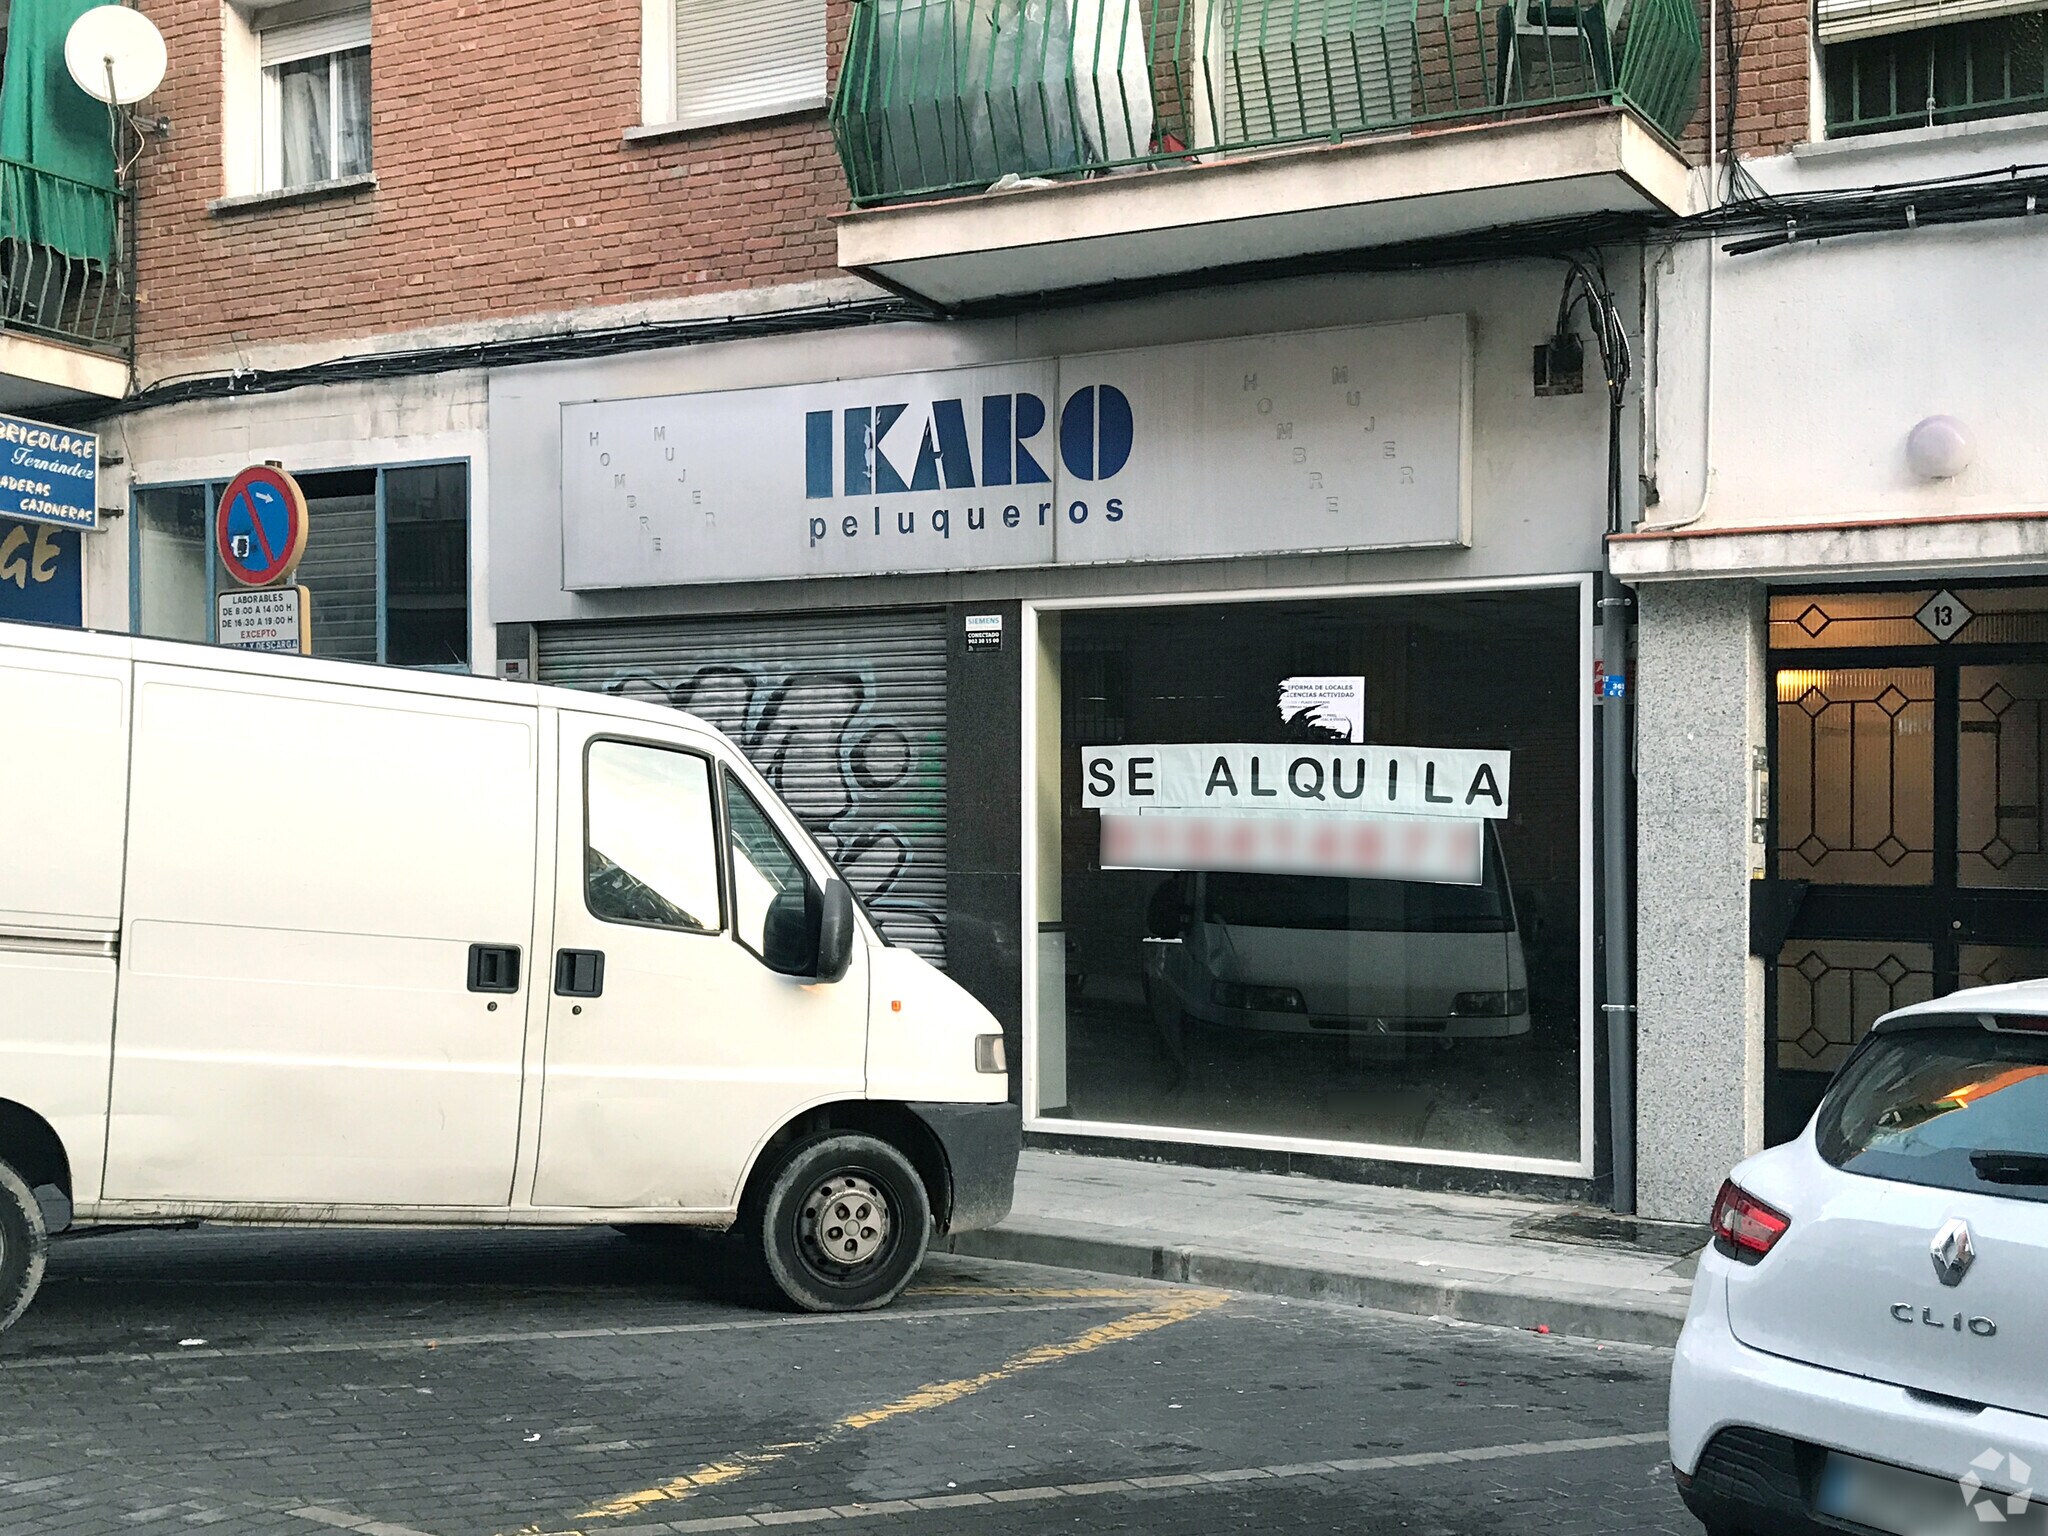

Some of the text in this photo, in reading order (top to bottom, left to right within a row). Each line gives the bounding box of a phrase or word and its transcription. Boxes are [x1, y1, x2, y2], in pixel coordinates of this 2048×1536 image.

[806, 384, 1134, 500] IKARO
[10, 447, 94, 479] Fernández
[0, 475, 51, 496] ADERAS
[20, 498, 93, 522] CAJONERAS
[809, 498, 1124, 547] peluqueros
[232, 593, 284, 604] LABORABLES
[222, 607, 233, 616] DE
[255, 605, 261, 614] A
[1934, 605, 1953, 626] 13
[221, 619, 232, 628] DE
[257, 617, 263, 626] A
[240, 629, 277, 639] EXCEPTO
[256, 640, 297, 650] DESCARGA
[1088, 756, 1503, 807] SE ALQUILA
[1890, 1302, 1997, 1337] CLIO
